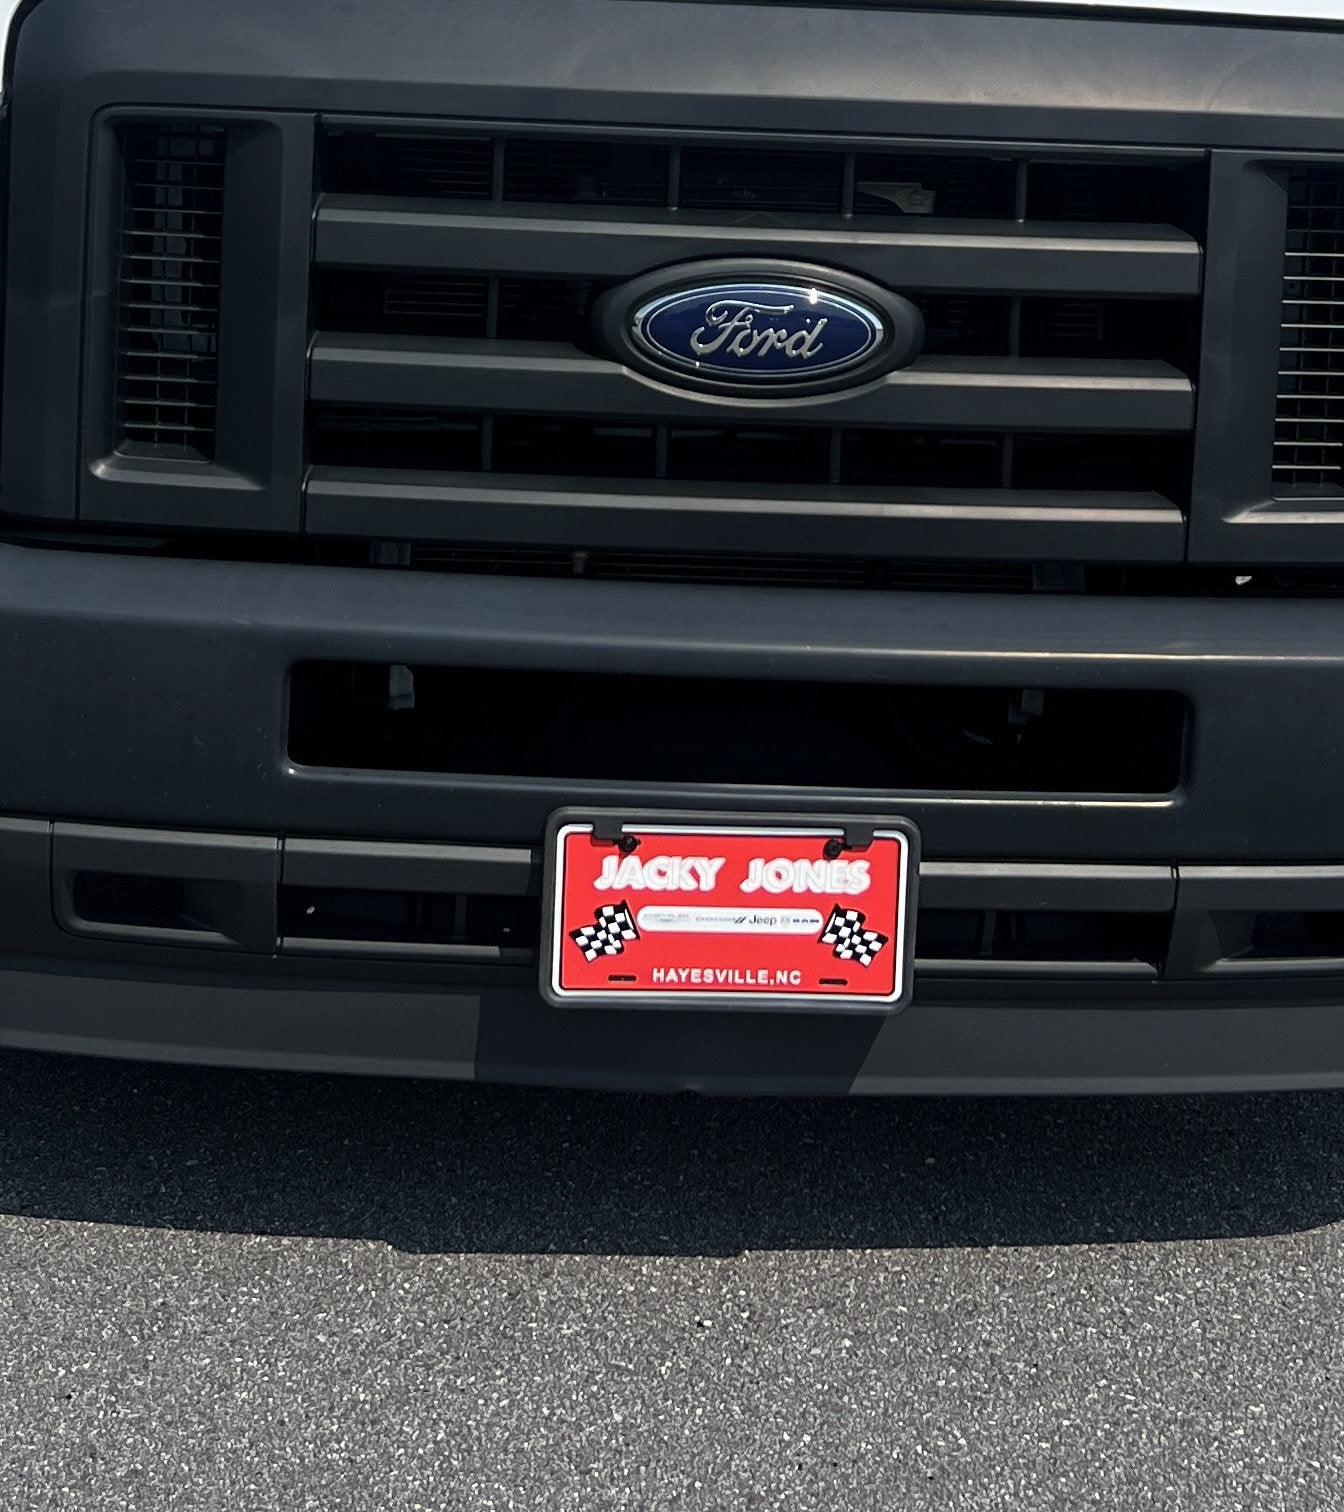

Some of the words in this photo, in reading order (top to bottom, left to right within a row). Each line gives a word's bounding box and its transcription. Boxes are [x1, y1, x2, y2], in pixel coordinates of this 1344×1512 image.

[690, 299, 828, 359] Ford
[593, 854, 726, 892] JACKY
[739, 857, 872, 895] JONES
[749, 914, 778, 927] Jeep
[652, 967, 802, 988] HAYESVILLE,NC
